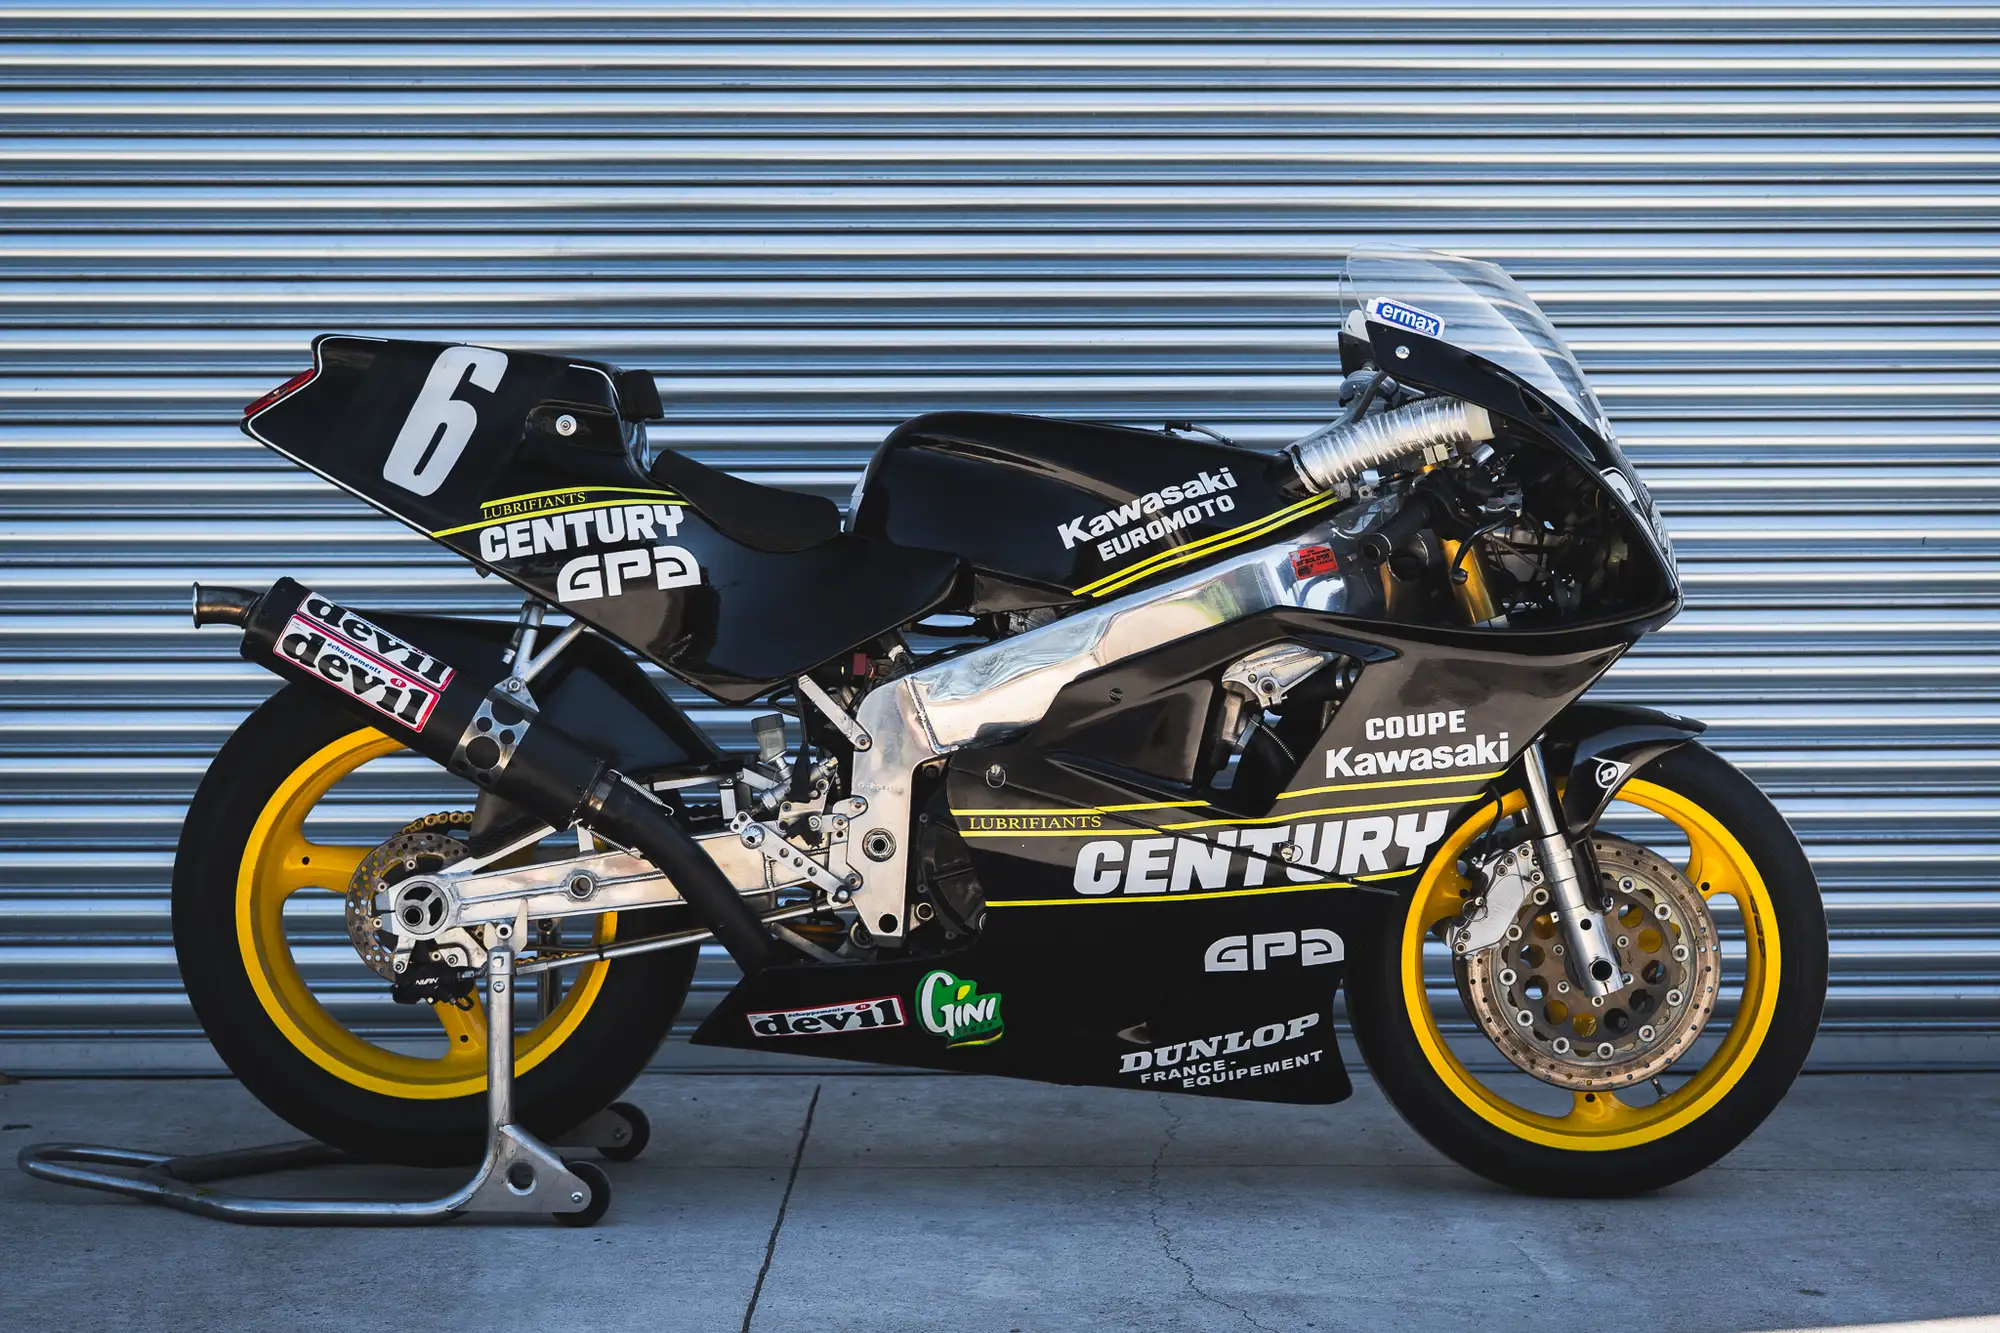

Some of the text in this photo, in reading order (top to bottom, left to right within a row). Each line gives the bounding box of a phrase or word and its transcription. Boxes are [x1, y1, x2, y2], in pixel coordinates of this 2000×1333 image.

[1381, 304, 1438, 334] ermax
[382, 345, 509, 497] 6
[483, 491, 587, 520] LUBRIFIANTS
[1057, 467, 1238, 550] Kawasaki
[1096, 494, 1236, 562] EUROMOTO
[479, 505, 685, 563] CENTURY
[306, 598, 448, 684] devil
[326, 640, 382, 675] échappements
[281, 632, 429, 725] devil
[1365, 709, 1467, 741] COUPE
[1326, 733, 1510, 779] Kawasaki
[969, 814, 1102, 832] LUBRIFIANTS
[1073, 809, 1450, 896] CENTURY
[753, 999, 902, 1036] devil
[1118, 1012, 1320, 1074] DUNLOP
[1183, 1049, 1324, 1089] EQUIPEMENT
